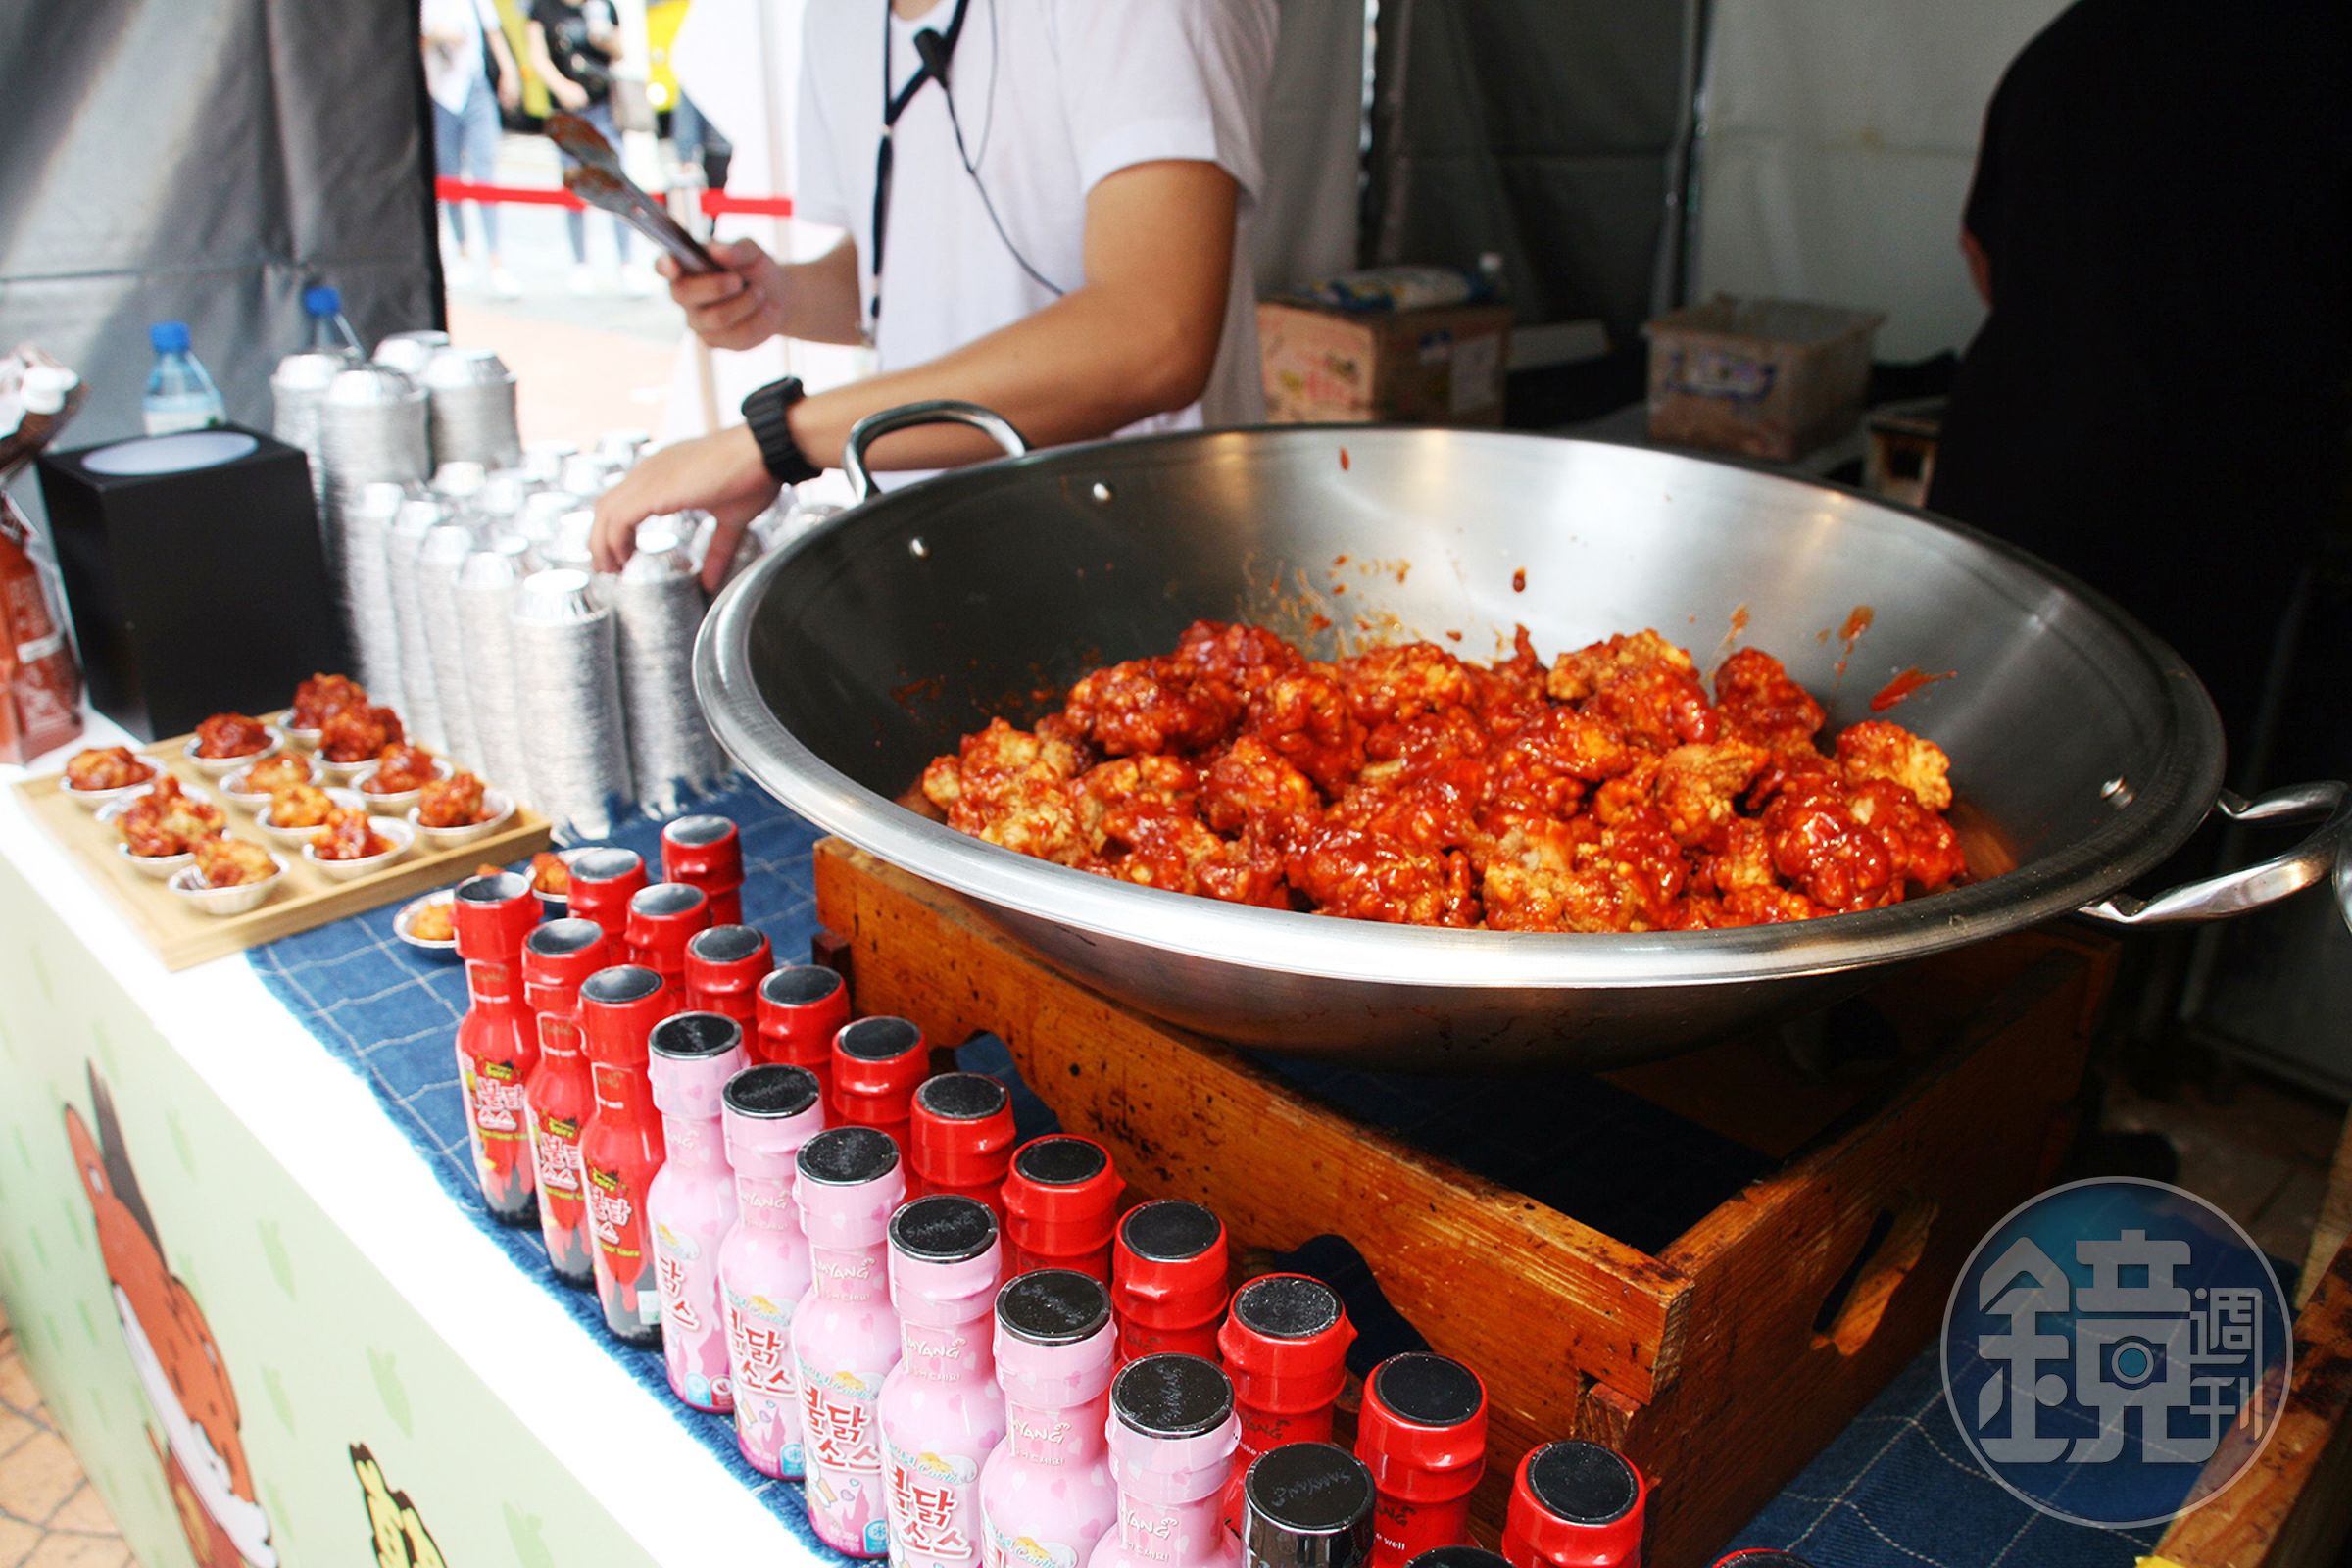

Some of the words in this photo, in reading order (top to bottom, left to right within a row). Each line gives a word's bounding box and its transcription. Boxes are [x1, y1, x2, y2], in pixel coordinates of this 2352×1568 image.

[816, 1437, 881, 1473] 소스
[902, 1520, 972, 1559] 소스
[1383, 1537, 1405, 1550] well
